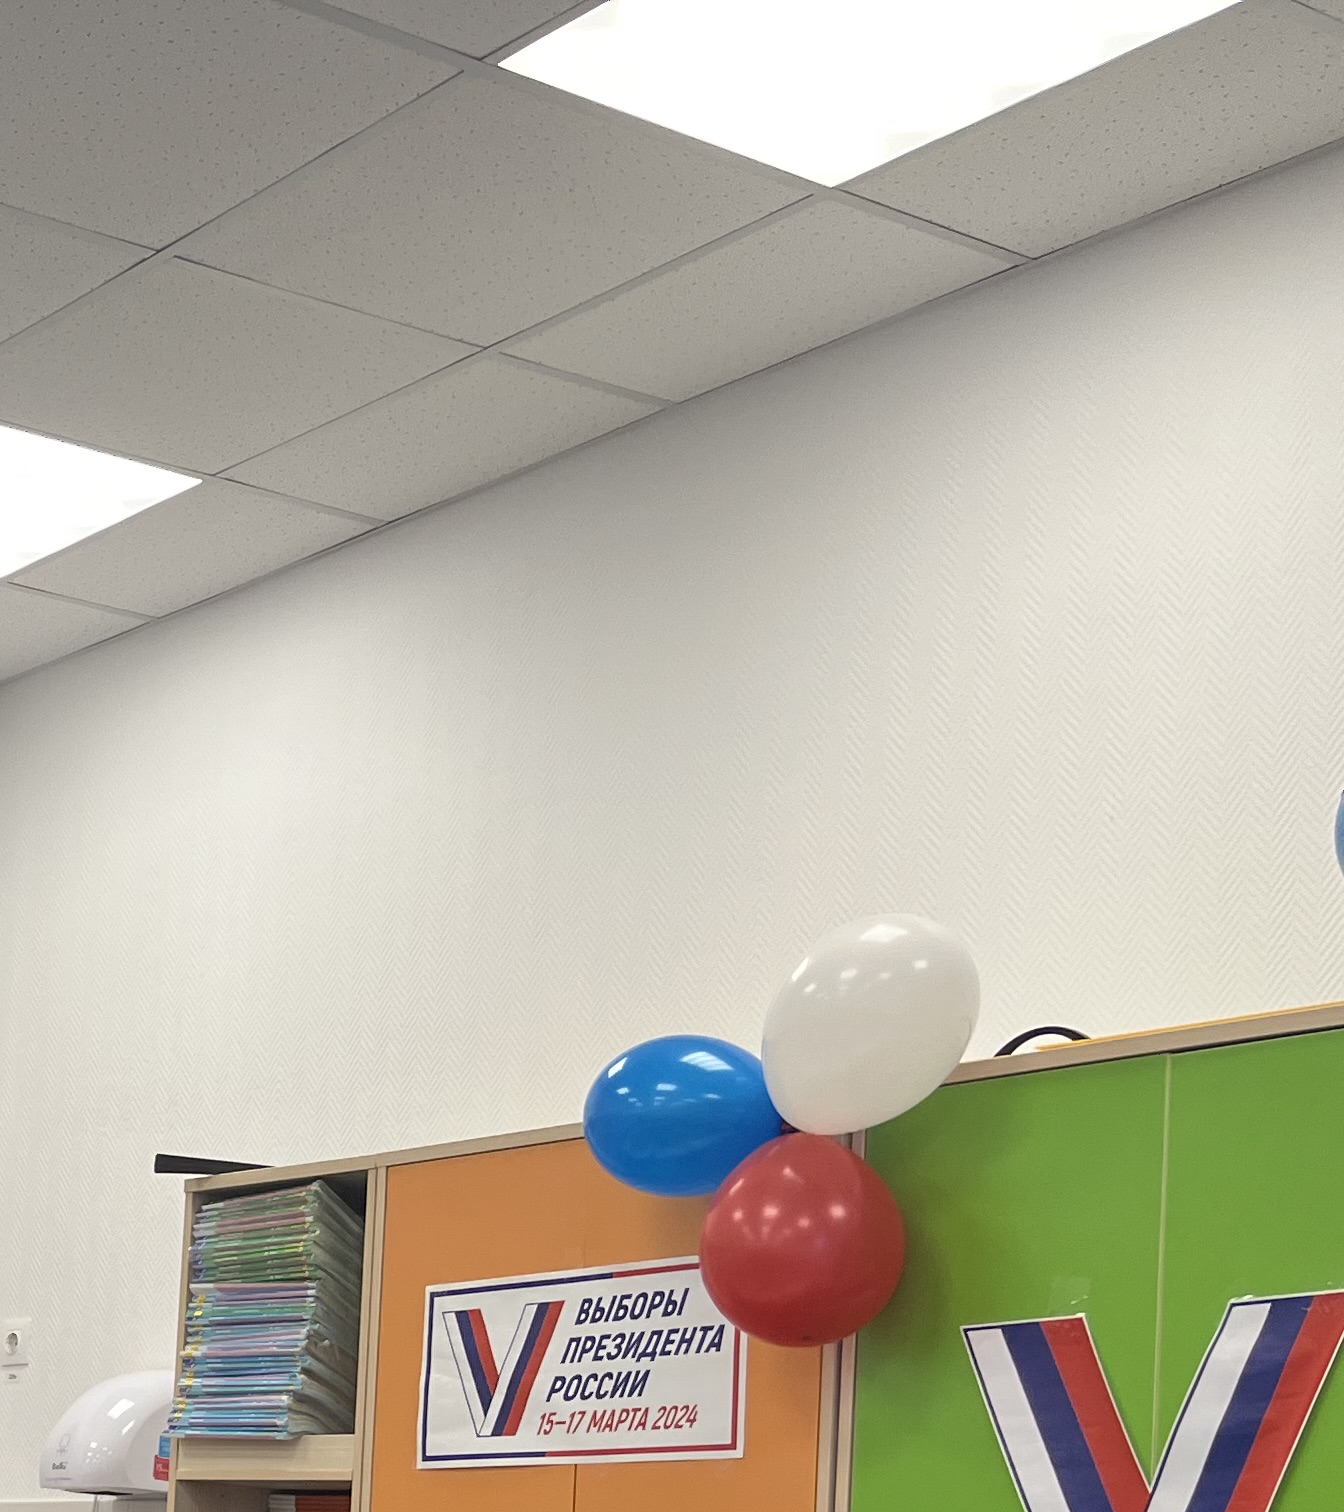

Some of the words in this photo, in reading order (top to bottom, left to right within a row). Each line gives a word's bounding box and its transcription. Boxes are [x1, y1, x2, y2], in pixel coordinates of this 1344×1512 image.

[575, 1288, 690, 1325] ВЫБОРЫ
[561, 1324, 726, 1365] ПРЕЗИДЕНТА
[546, 1369, 651, 1403] РОССИИ
[586, 1407, 648, 1433] МАРТА
[651, 1404, 699, 1431] 2024
